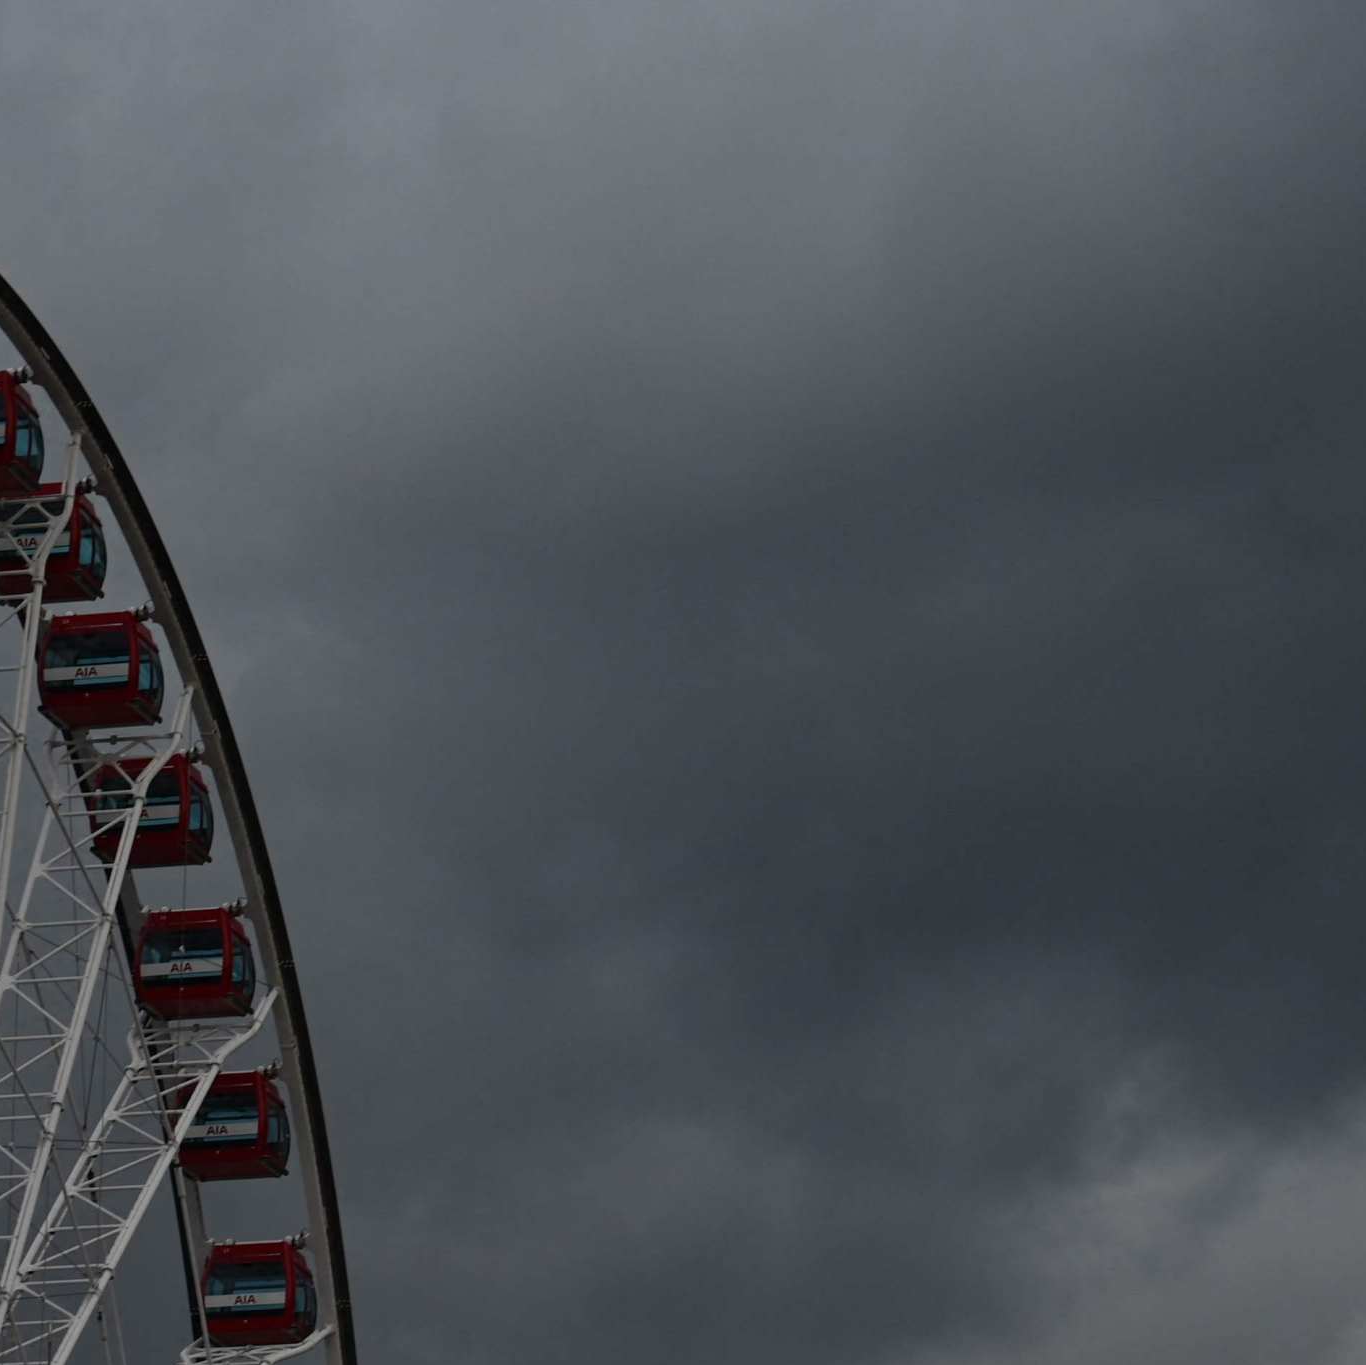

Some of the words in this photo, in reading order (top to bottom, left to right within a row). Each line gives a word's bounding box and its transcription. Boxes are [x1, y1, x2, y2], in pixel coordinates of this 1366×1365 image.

[75, 667, 97, 677] AIA
[171, 962, 192, 972] AIA
[207, 1126, 227, 1135] AIA
[235, 1295, 256, 1305] AIA
